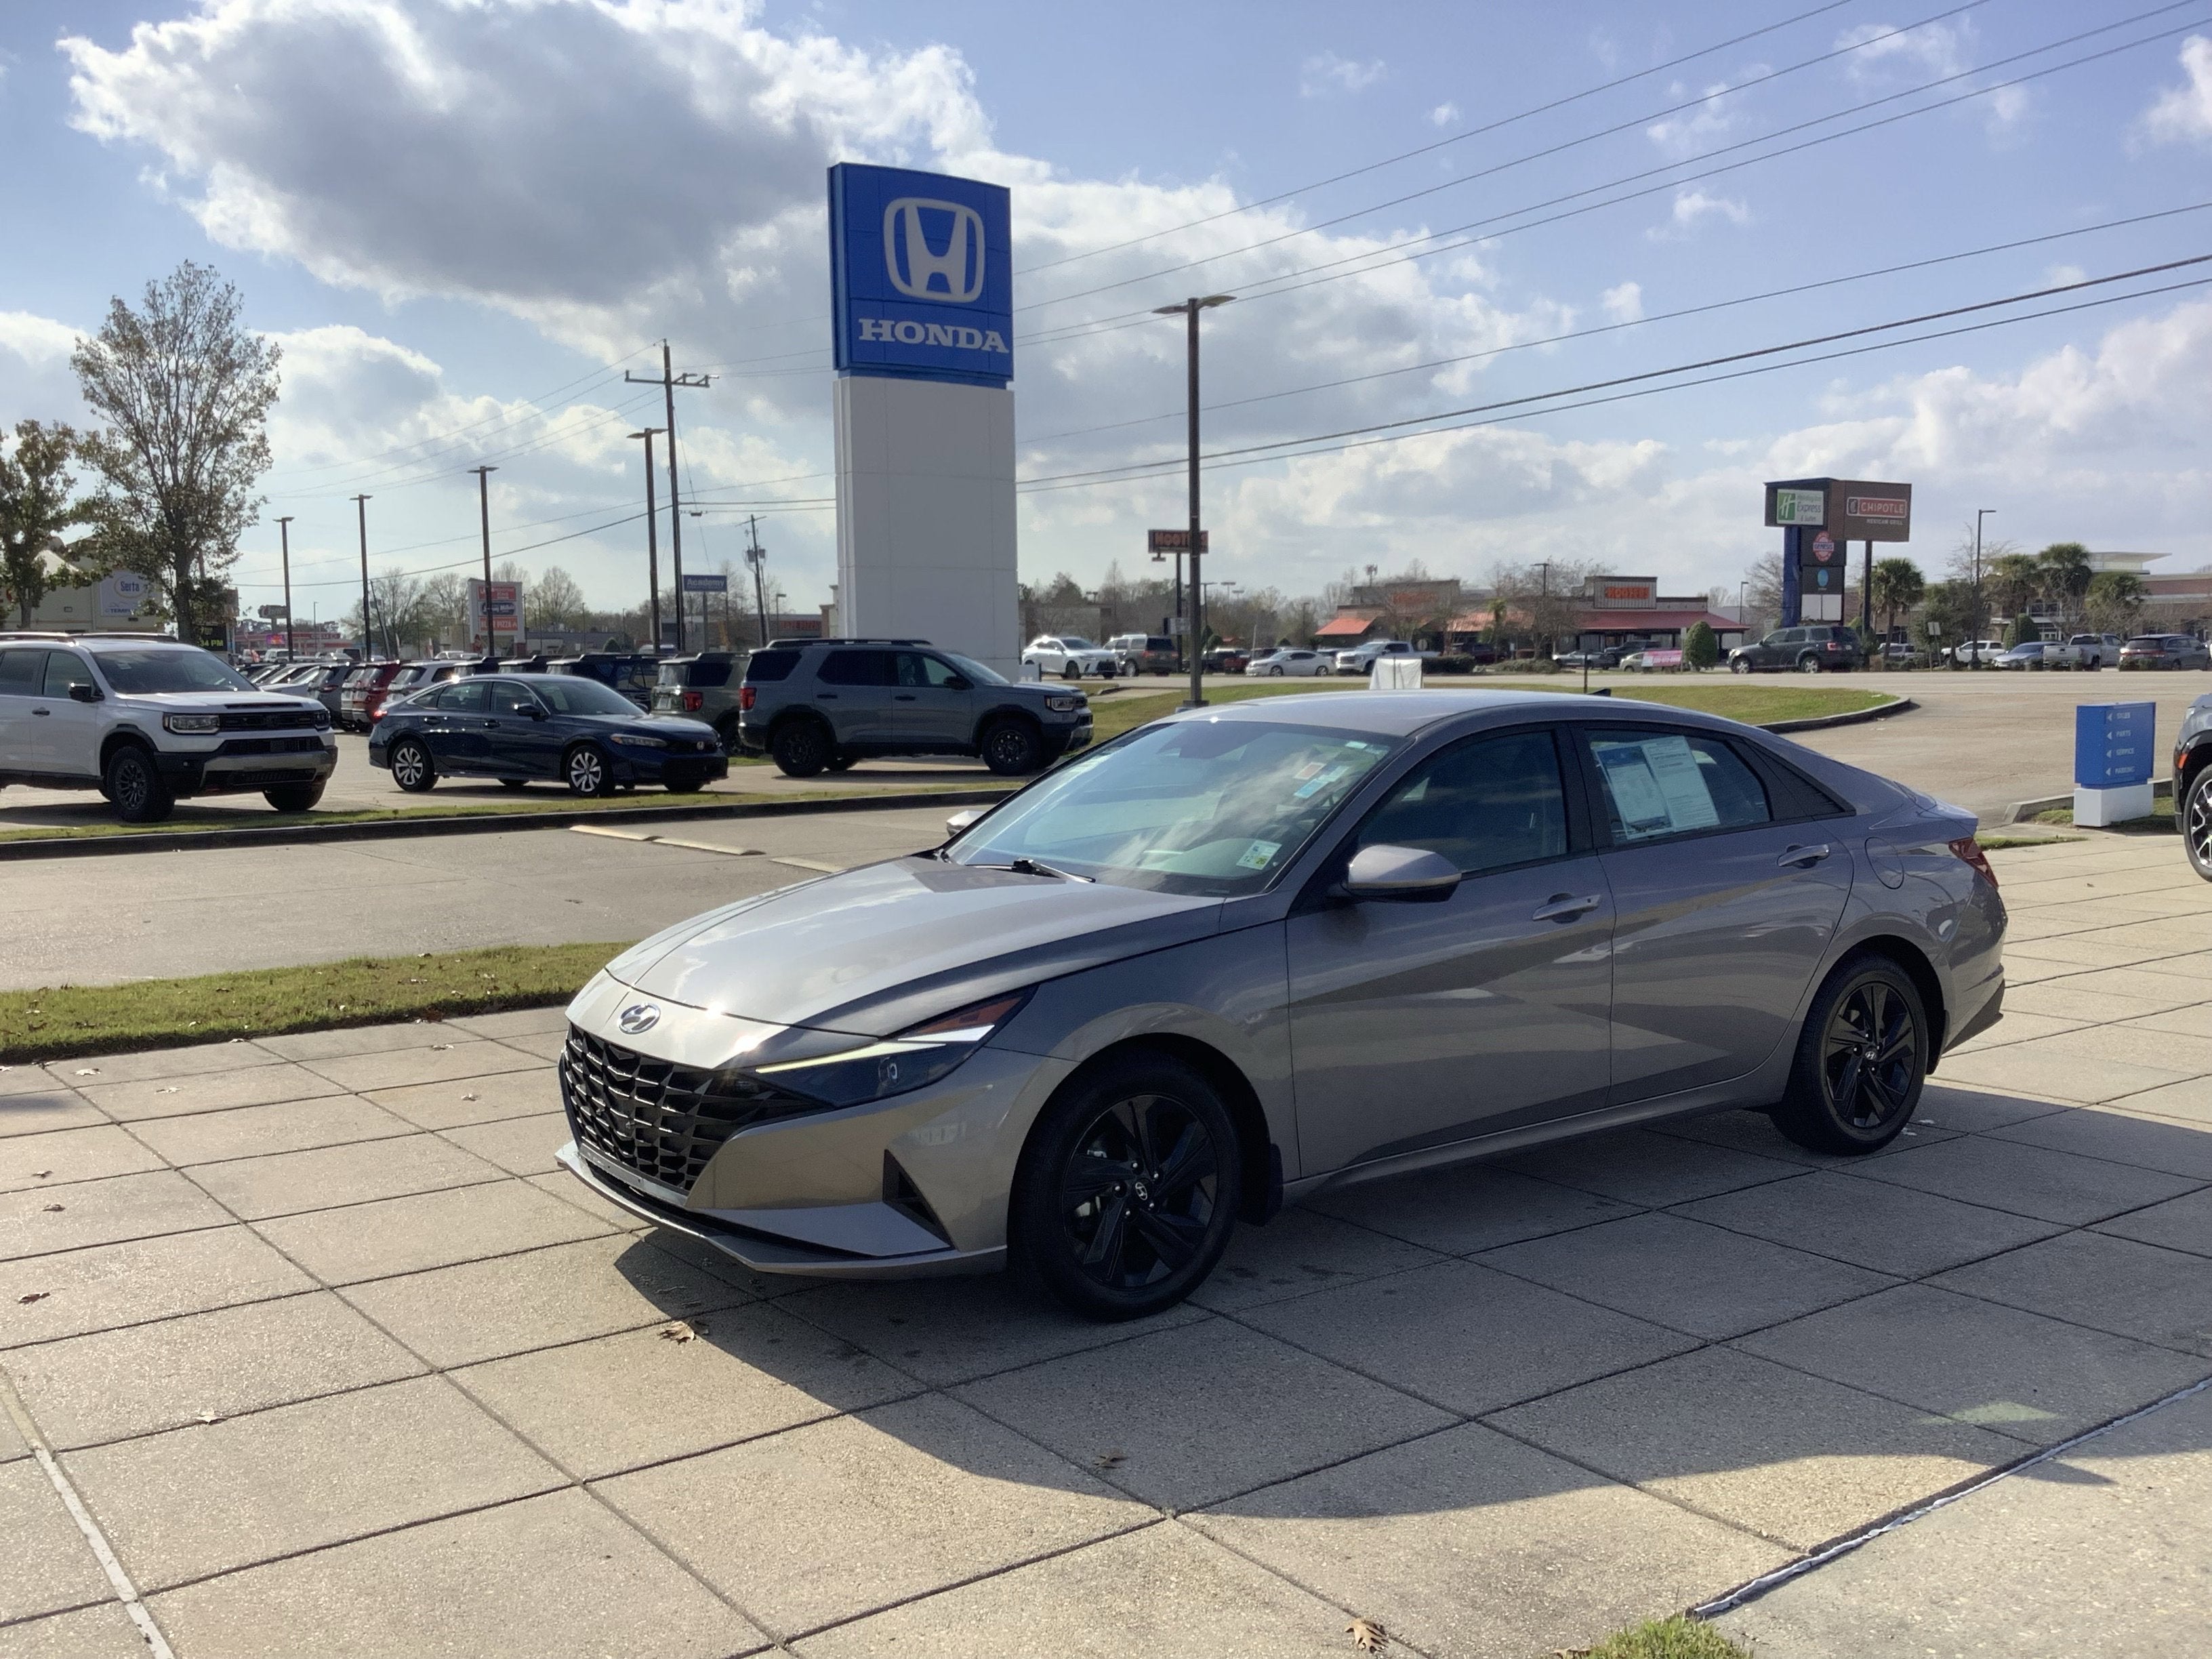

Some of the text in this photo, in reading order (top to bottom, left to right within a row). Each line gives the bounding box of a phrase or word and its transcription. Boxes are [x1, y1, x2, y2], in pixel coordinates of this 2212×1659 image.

[858, 318, 1010, 354] HONDA
[1797, 501, 1821, 512] Express
[1861, 502, 1904, 514] CHIPOTLE
[120, 581, 140, 592] Serta
[687, 578, 725, 586] Academy
[2116, 747, 2135, 756] SERVICE
